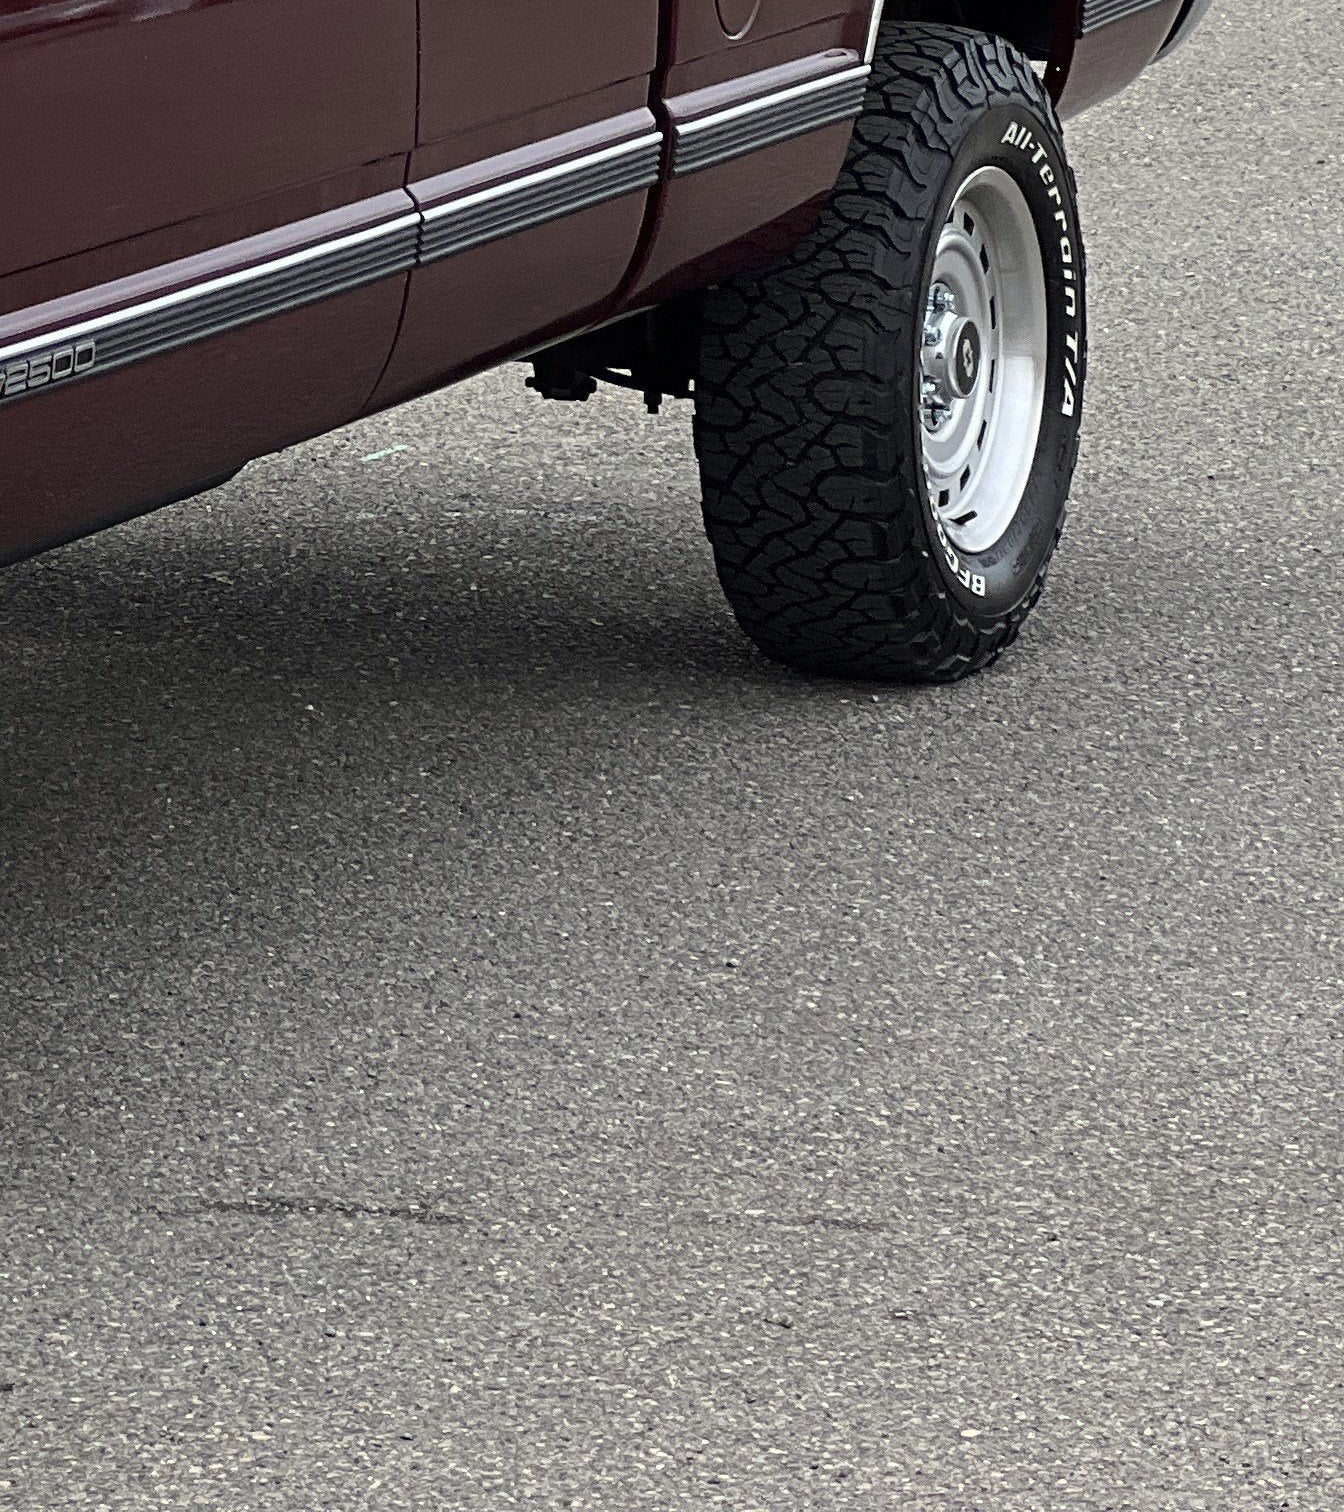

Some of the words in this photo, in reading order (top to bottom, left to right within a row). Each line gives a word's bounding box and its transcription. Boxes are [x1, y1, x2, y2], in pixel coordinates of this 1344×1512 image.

[1001, 121, 1077, 317] All-Terrain
[1061, 331, 1078, 418] T/A
[4, 341, 96, 396] 2500
